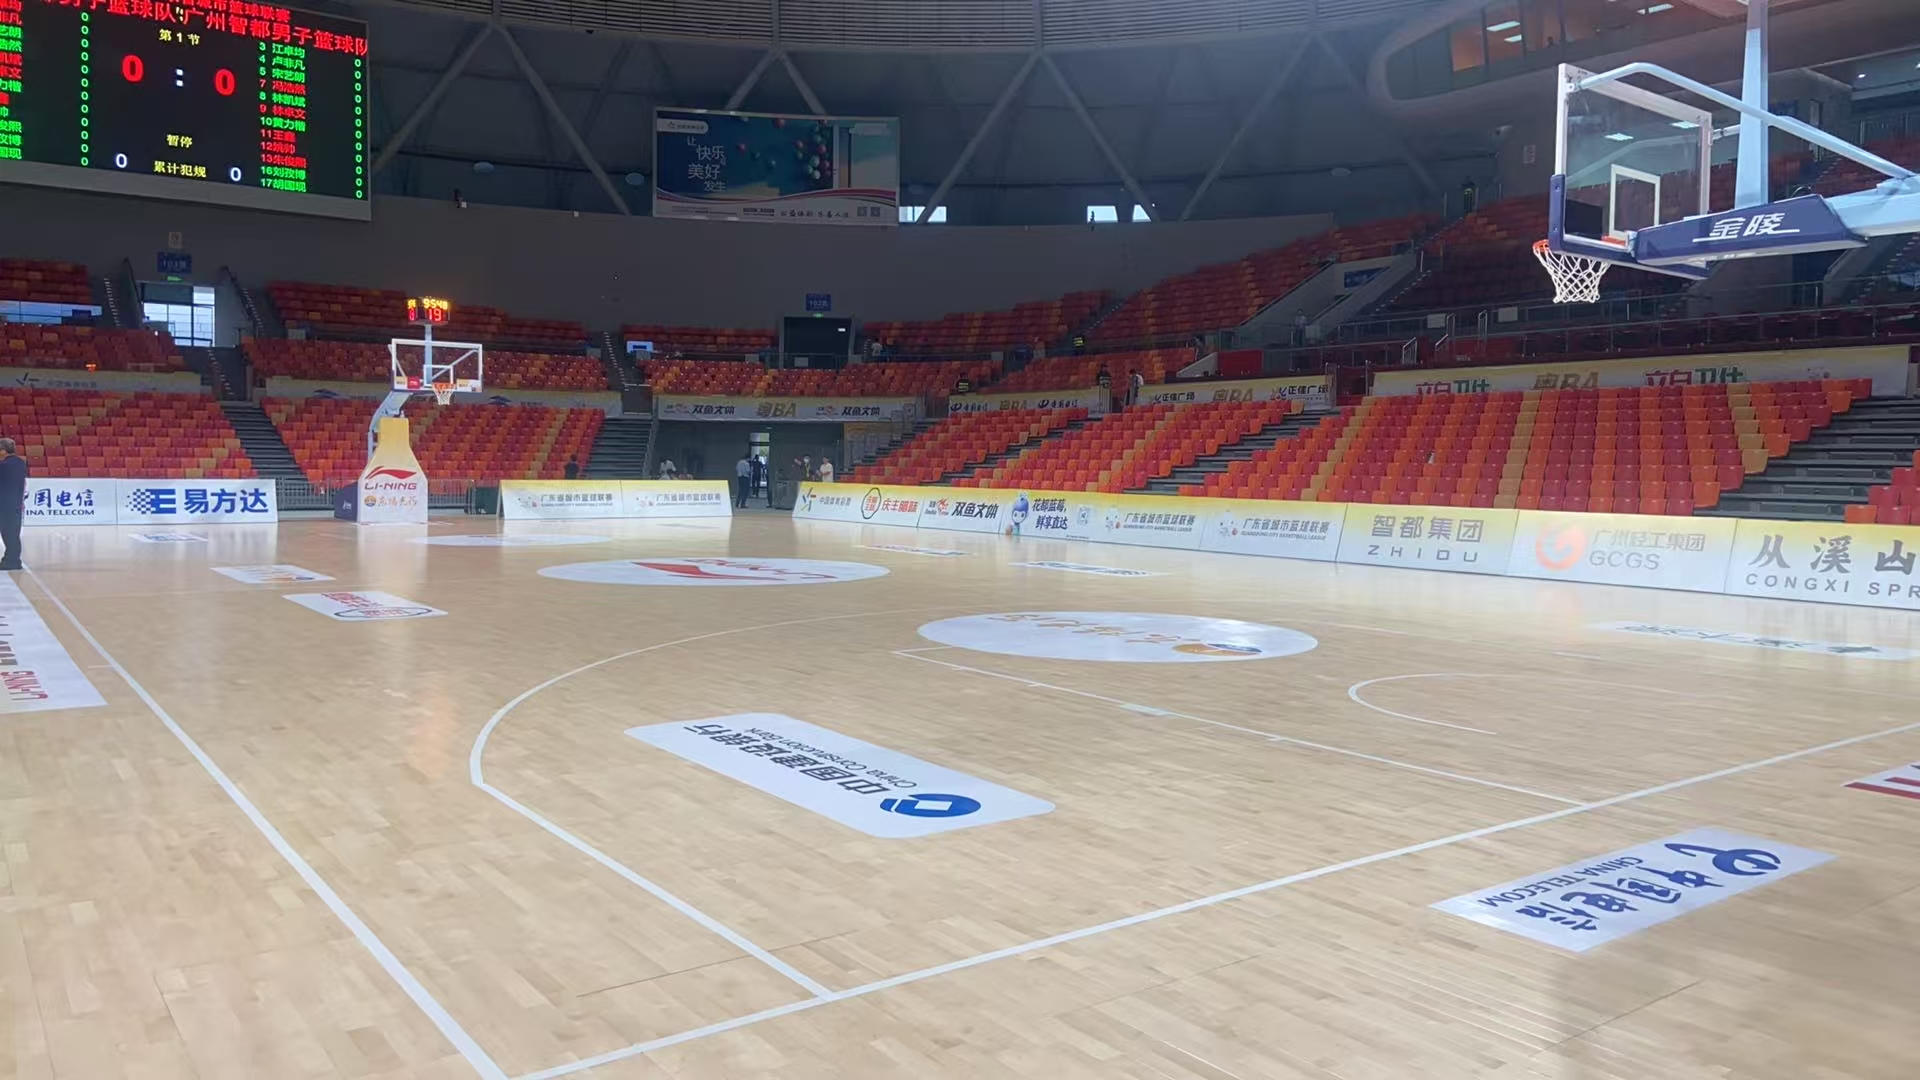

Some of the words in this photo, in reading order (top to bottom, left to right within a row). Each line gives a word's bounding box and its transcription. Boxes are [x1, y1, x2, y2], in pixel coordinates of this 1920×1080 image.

[81, 12, 88, 21] 0
[81, 26, 88, 34] 0
[183, 7, 368, 56] 广州智都男子篮球队
[81, 39, 88, 47] 0
[81, 52, 88, 61] 0
[258, 54, 266, 63] 4
[259, 42, 266, 51] 3
[354, 59, 361, 67] 0
[81, 65, 88, 74] 0
[122, 55, 144, 82] 0
[214, 69, 235, 96] 0
[81, 78, 88, 87] 0
[259, 66, 266, 76] 5
[355, 83, 362, 91] 0
[259, 79, 267, 88] 7
[81, 92, 88, 100] 0
[259, 91, 266, 101] 8
[81, 104, 88, 113] 0
[260, 104, 267, 113] 9
[81, 118, 88, 126] 0
[260, 116, 273, 126] 10
[81, 131, 88, 139] 0
[167, 134, 192, 148] 暂停
[260, 129, 272, 138] 11
[81, 144, 88, 152] 0
[260, 141, 273, 151] 12
[696, 144, 724, 161] 快乐
[81, 157, 88, 166] 0
[260, 154, 273, 163] 13
[115, 153, 128, 168] 0
[154, 160, 207, 178] 累计犯规
[230, 167, 242, 182] 0
[260, 166, 273, 175] 16
[688, 161, 721, 180] 美好
[260, 178, 273, 188] 17
[356, 190, 363, 198] 0
[1693, 212, 1800, 243] 金陵
[428, 307, 442, 322] 19
[364, 482, 418, 491] LI-NING
[24, 488, 94, 508] 国电信
[184, 488, 268, 514] 易方达
[952, 501, 999, 519] 双鱼文体
[1035, 515, 1068, 530] 鲜享直达
[1124, 512, 1196, 526] 广东省城市篮球联赛
[1243, 518, 1330, 533] 广东省城市篮球联赛
[1371, 514, 1484, 543] 智都集团
[1591, 529, 1706, 552] 广州轻工集团
[1589, 550, 1661, 570] GCGS
[1748, 535, 1917, 575] 从溪山
[1745, 573, 1850, 592] CONGXI
[683, 723, 891, 796] 中国建设银行
[778, 735, 868, 772] Construction
[865, 768, 918, 790] China
[1574, 856, 1644, 878] CHINA
[1477, 874, 1587, 908] TELECOM
[1515, 864, 1725, 931] 中国电信
